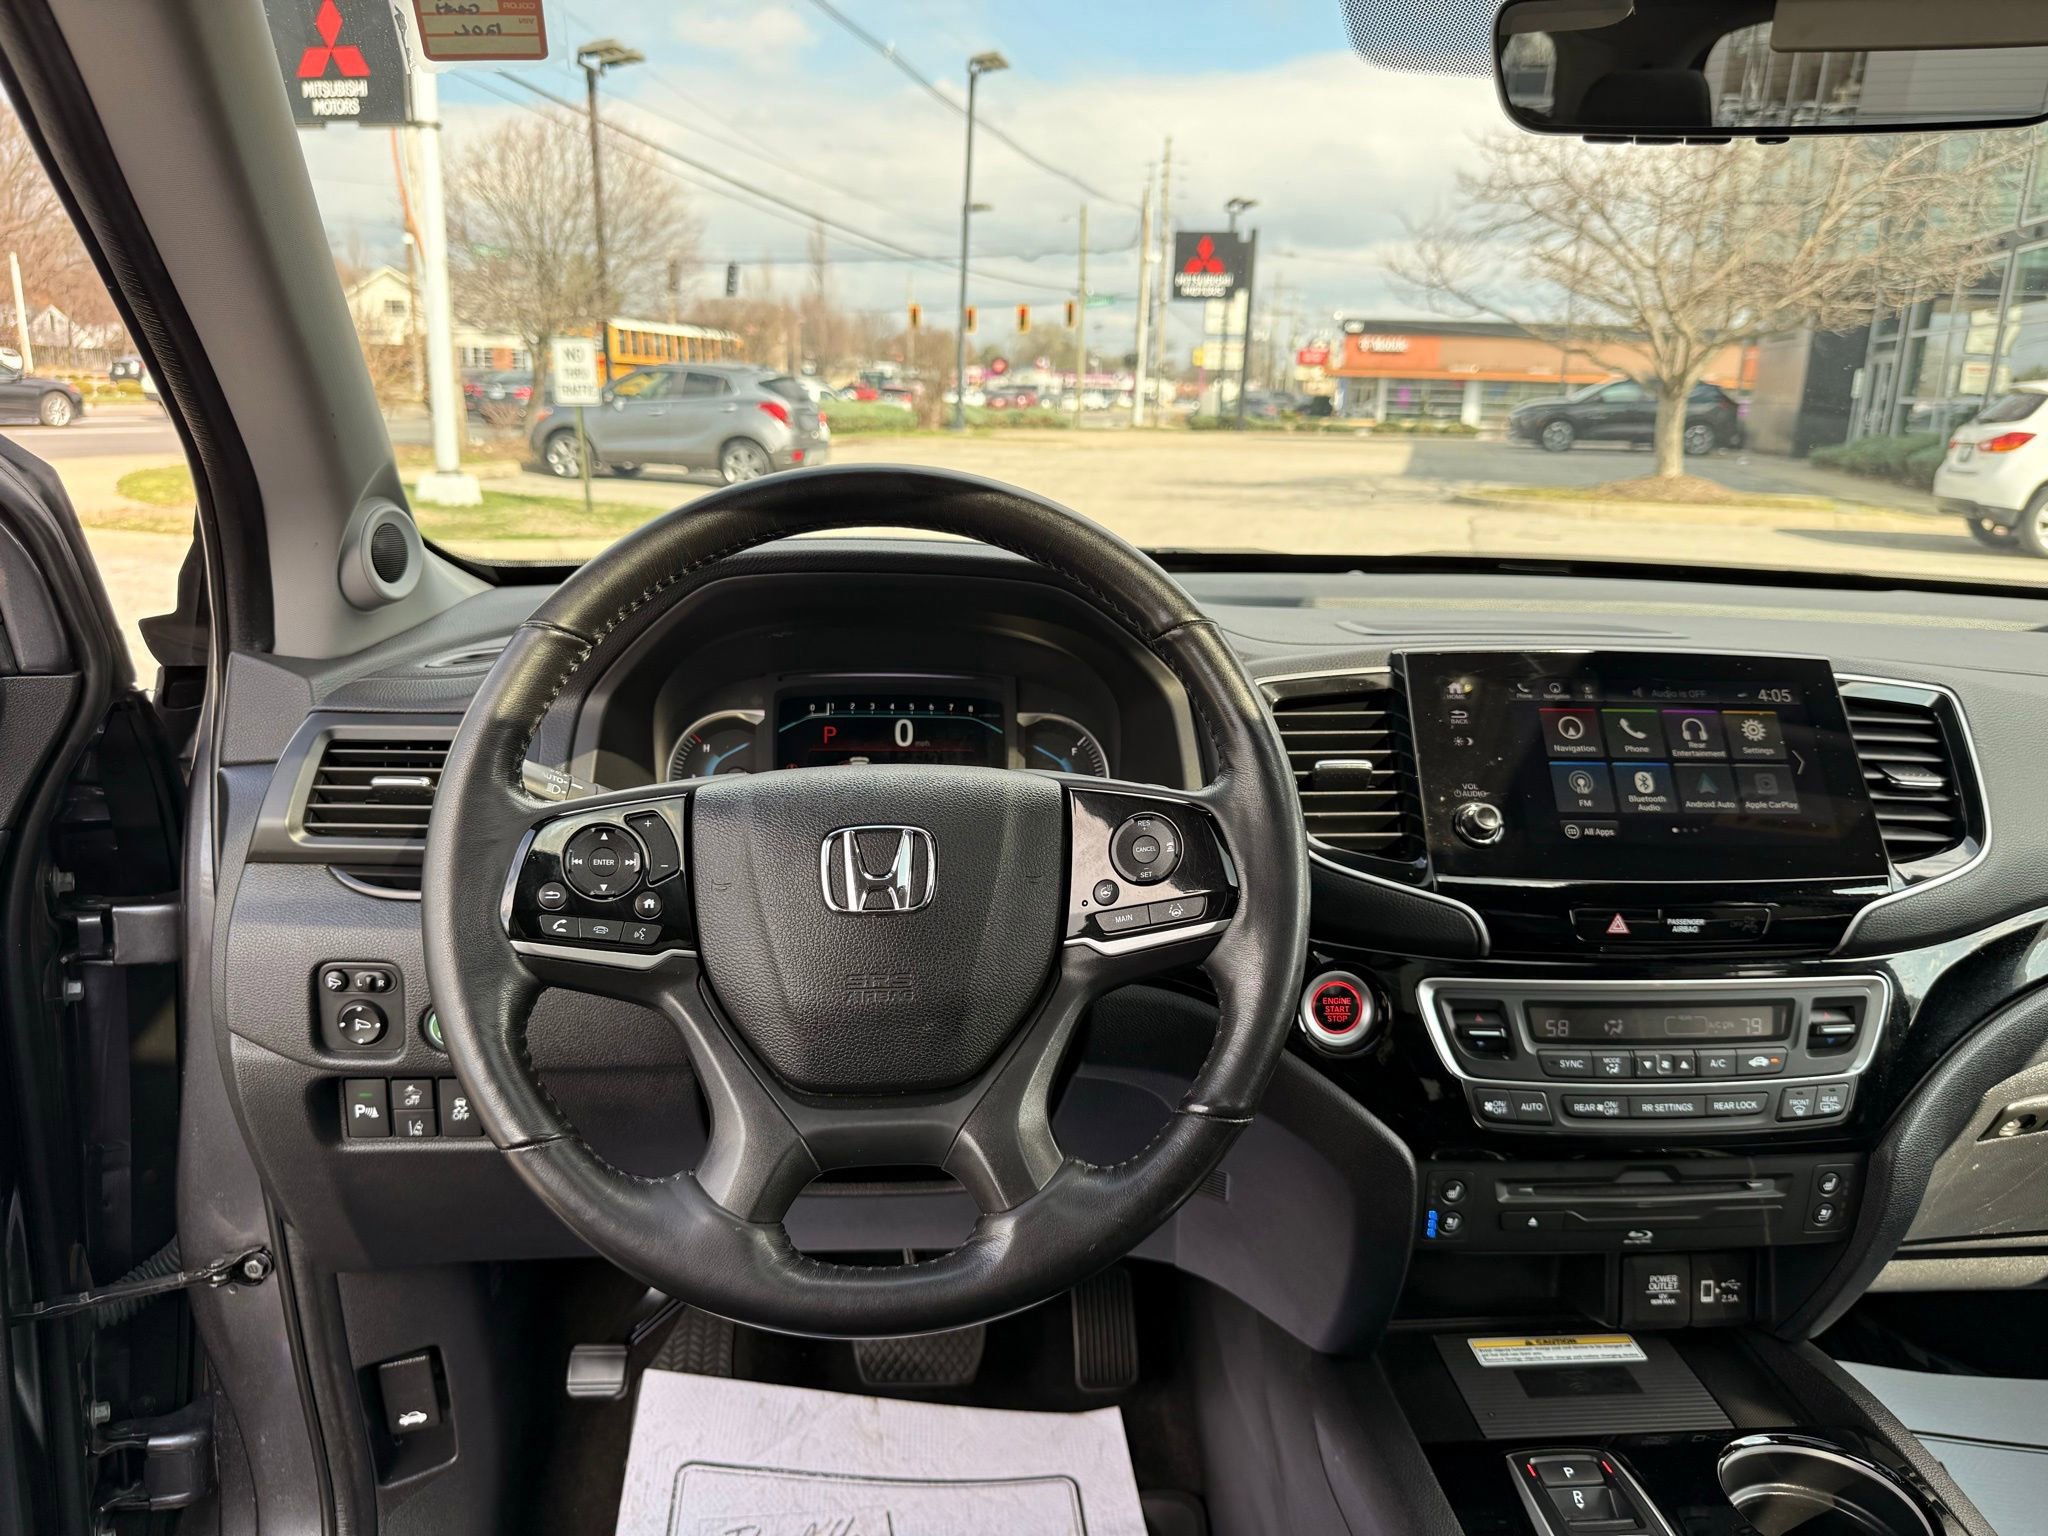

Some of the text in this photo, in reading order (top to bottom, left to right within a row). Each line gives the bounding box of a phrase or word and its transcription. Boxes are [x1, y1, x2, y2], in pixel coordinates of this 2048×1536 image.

[301, 79, 369, 98] MITSUBISHI
[311, 97, 361, 116] MOTORS
[562, 346, 586, 363] NO
[1651, 688, 1677, 698] Audio
[1688, 689, 1707, 698] OFF
[1758, 689, 1792, 702] 4:05
[823, 726, 837, 744] P
[894, 719, 914, 747] 0
[1071, 747, 1078, 756] F
[1553, 744, 1596, 753] Navigation
[1624, 745, 1650, 753] Phone
[1742, 746, 1775, 756] Settings
[1672, 749, 1727, 758] Entertainment
[1628, 795, 1667, 803] Bluetooth
[1638, 804, 1661, 812] Audio
[1718, 801, 1736, 809] Auto
[1745, 801, 1799, 810] Apple CarPlay
[1137, 819, 1151, 827] RES
[1584, 828, 1615, 837] All Apps
[1135, 845, 1157, 853] CANCEL
[1115, 913, 1133, 923] MAIN
[1667, 918, 1706, 926] PASSENGER
[357, 979, 363, 987] L
[378, 979, 385, 987] R
[848, 974, 913, 988] SRS
[1322, 997, 1352, 1005] ENGINE
[1325, 1005, 1350, 1013] START
[1559, 1059, 1584, 1069] SYNC
[1710, 1059, 1727, 1068] A/C
[405, 1097, 420, 1106] OFF
[1713, 1100, 1757, 1110] REAR LOCK
[1521, 1103, 1543, 1111] AUTO
[1574, 1103, 1596, 1112] REAR
[1641, 1102, 1694, 1112] RR SETTINGS
[452, 1112, 470, 1121] OFF
[1649, 1274, 1678, 1282] POWER
[1648, 1282, 1679, 1290] OUTLET
[1721, 1294, 1739, 1303] 2.5A
[1562, 1466, 1575, 1478] P
[1572, 1490, 1584, 1504] R
